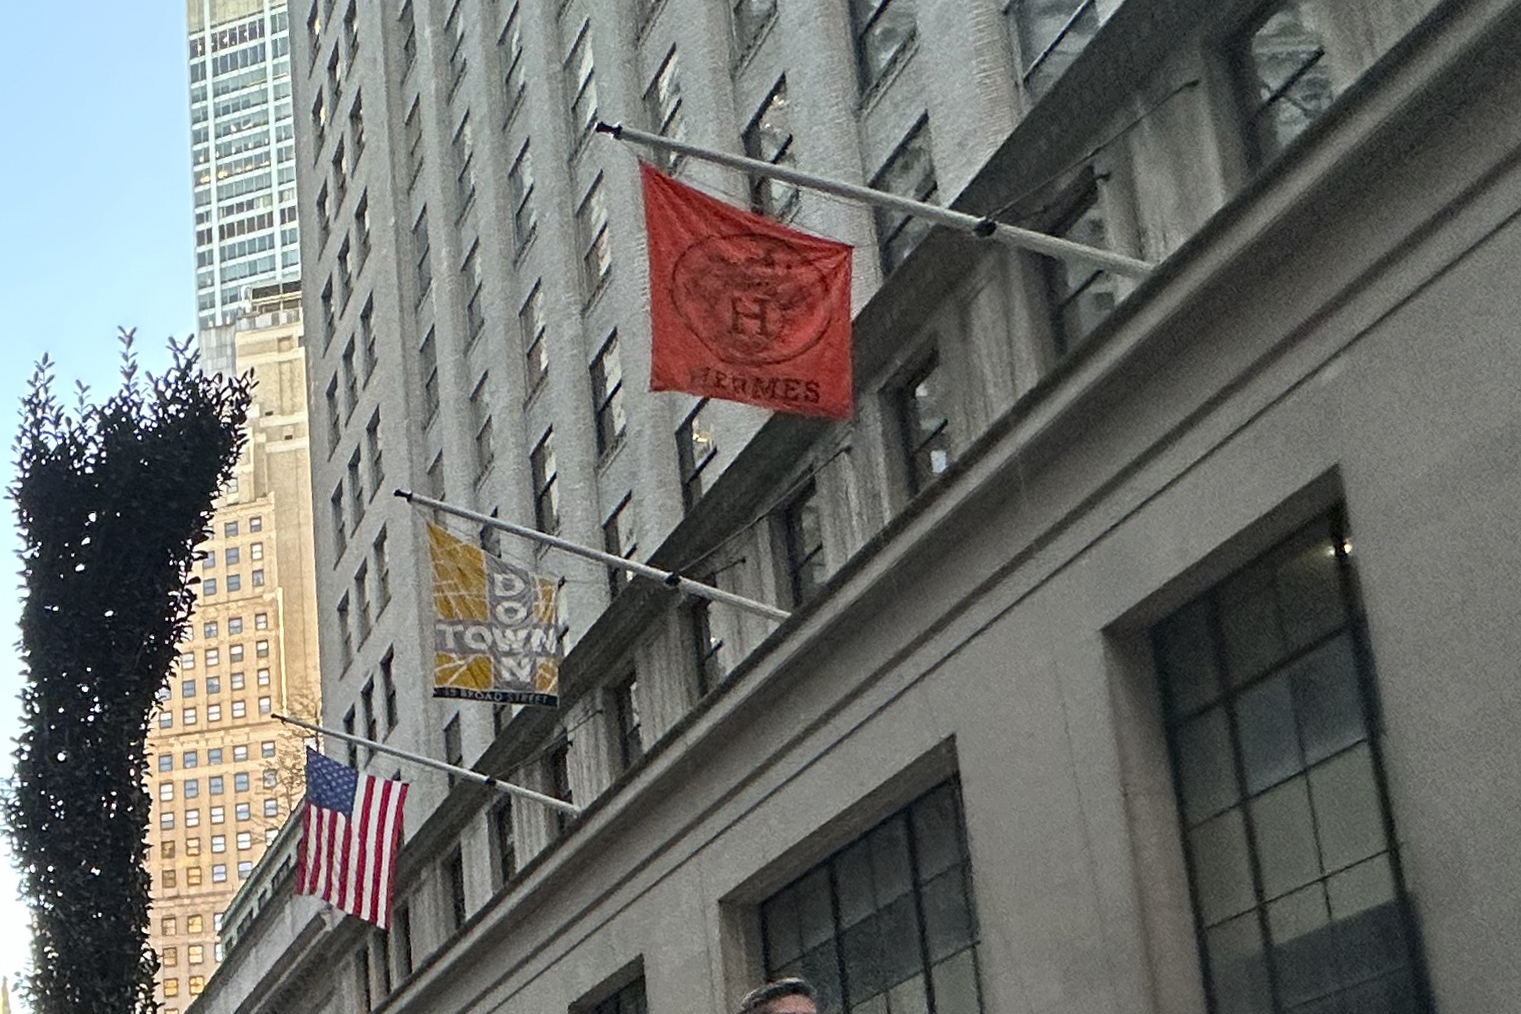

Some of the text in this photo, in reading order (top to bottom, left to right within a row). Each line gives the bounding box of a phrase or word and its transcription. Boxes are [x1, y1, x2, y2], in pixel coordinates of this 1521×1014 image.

[436, 624, 556, 655] TOWN
[461, 686, 502, 701] BROAD
[507, 690, 549, 704] STREET
